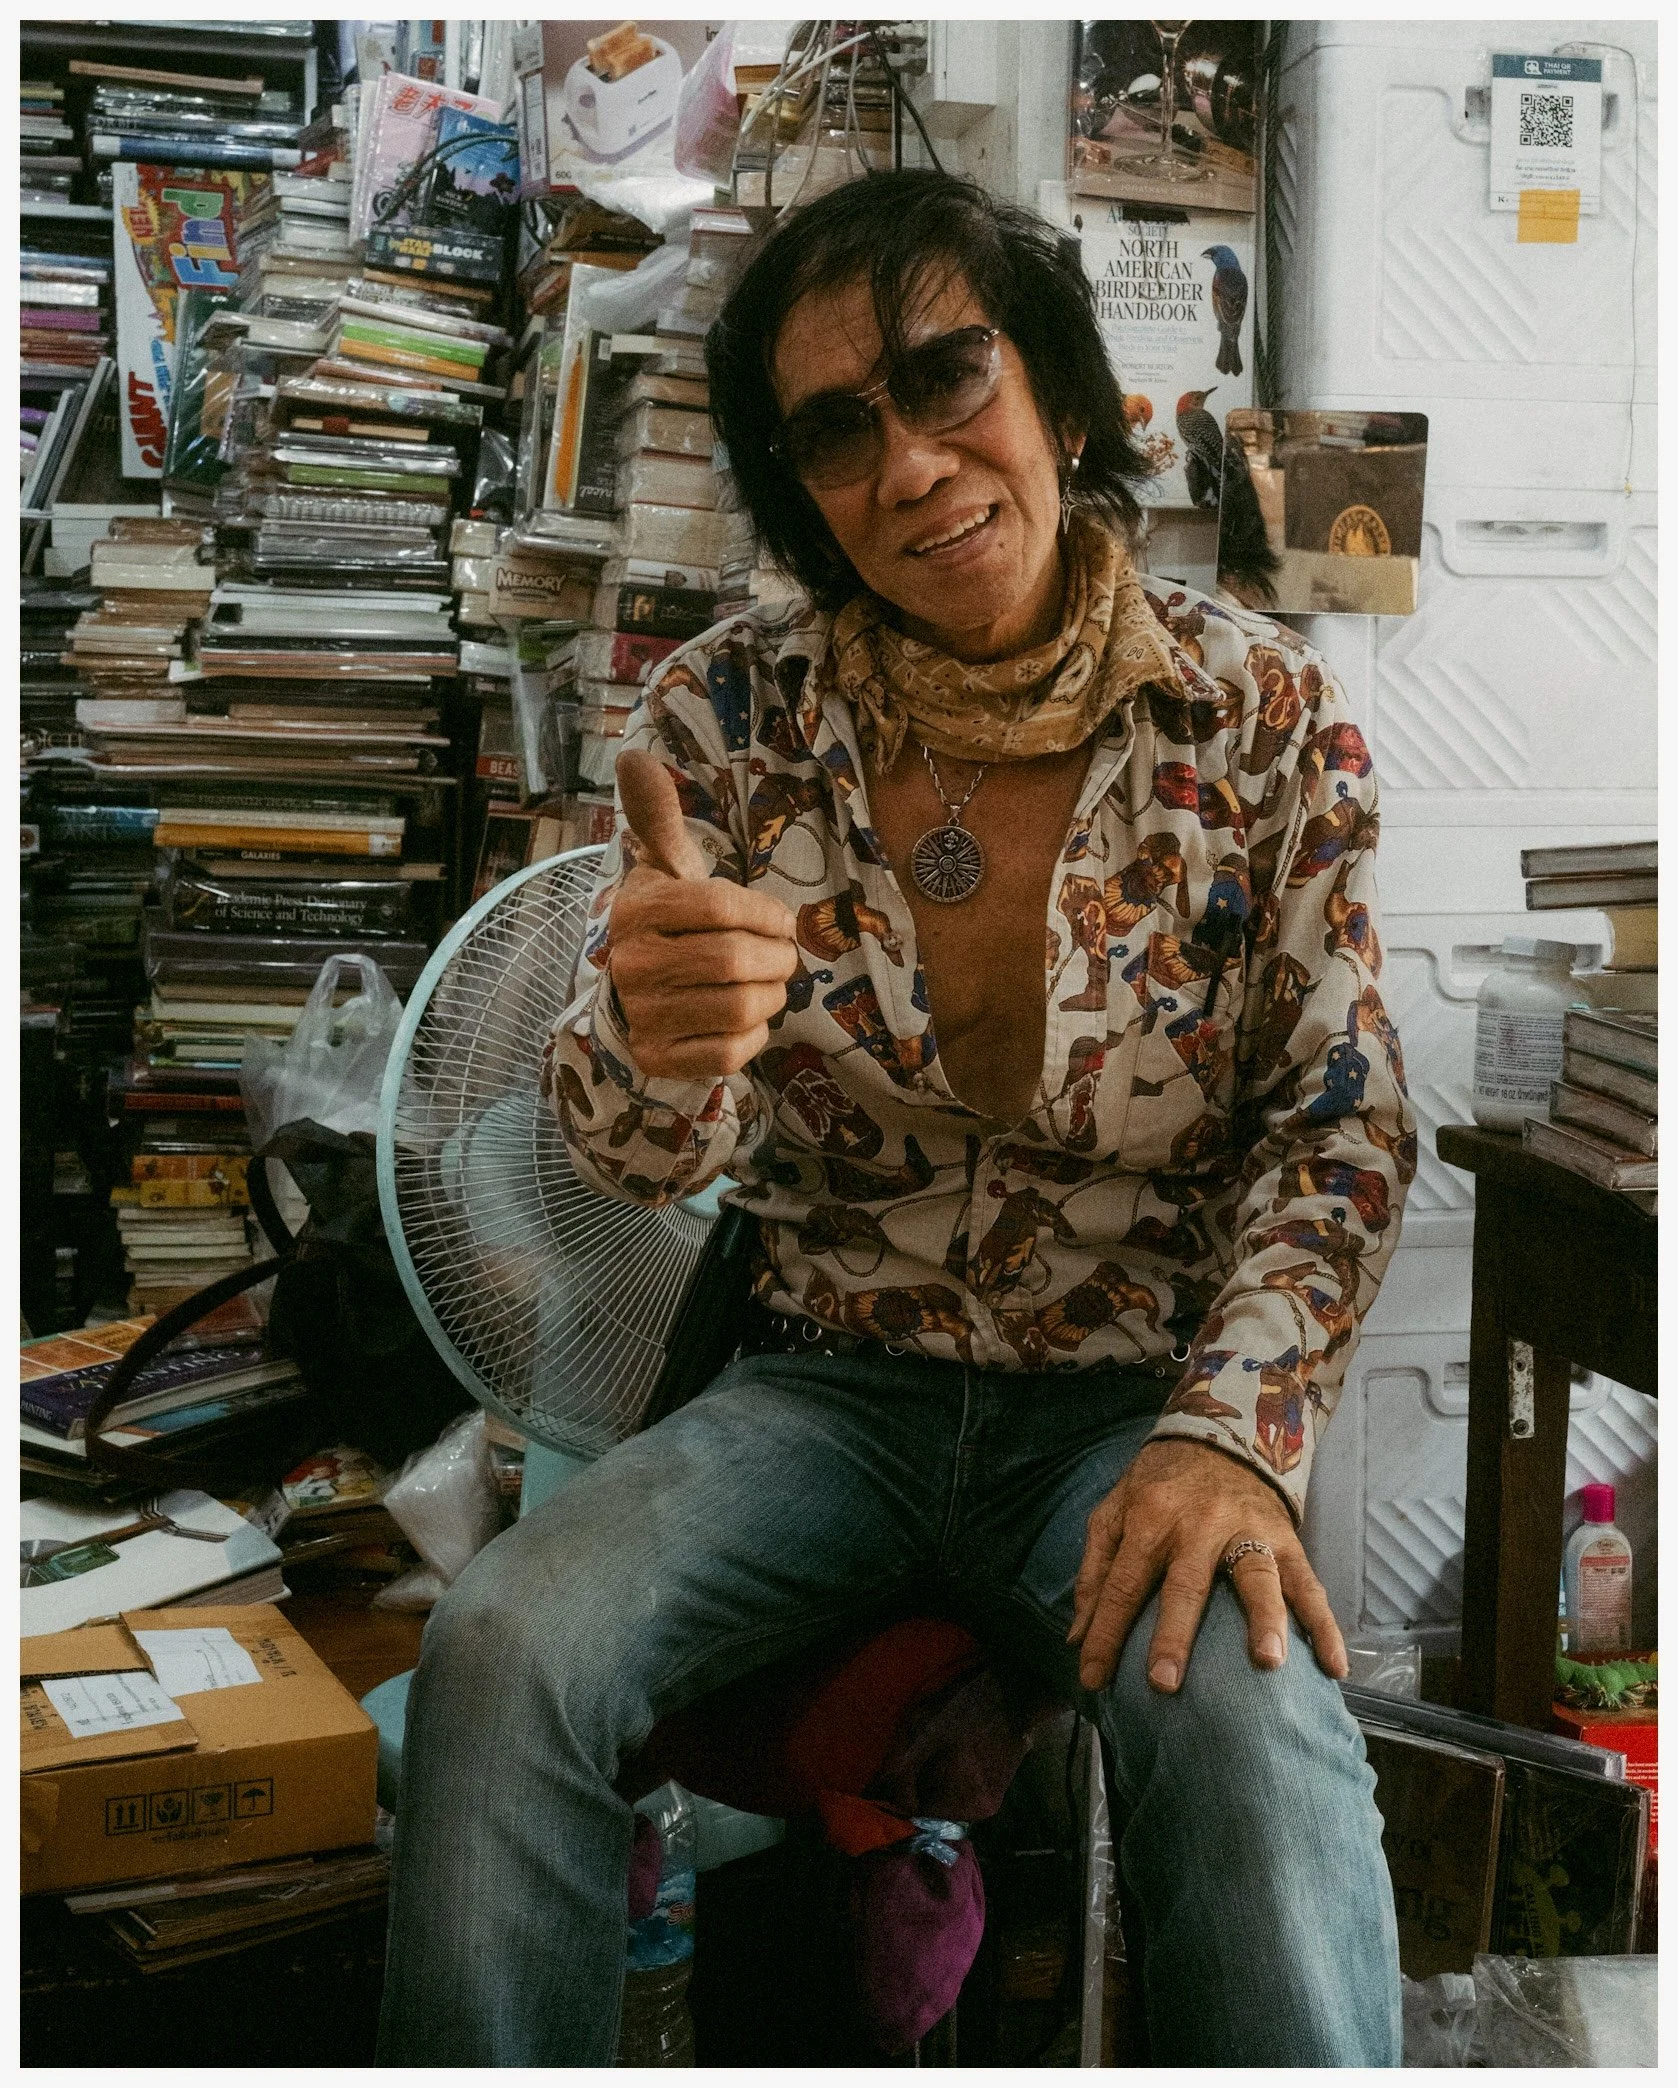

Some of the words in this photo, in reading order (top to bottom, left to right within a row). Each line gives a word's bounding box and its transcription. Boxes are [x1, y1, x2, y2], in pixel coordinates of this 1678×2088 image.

[1543, 61, 1561, 69] THAI
[161, 187, 239, 287] Find
[399, 238, 432, 249] STAR
[433, 243, 485, 260] BLOCK
[1119, 239, 1179, 259] NORTH
[1104, 260, 1194, 280] AMERICAN
[1094, 280, 1204, 301] BIRDFEEDER
[1099, 302, 1198, 322] HANDBOOK
[127, 371, 168, 469] GIANT
[496, 567, 567, 591] MEMORY
[489, 761, 520, 777] BEAS
[240, 851, 281, 861] GALAXIES
[275, 894, 303, 906] Press
[214, 905, 228, 918] of
[230, 906, 274, 920] Science
[276, 908, 297, 921] and
[299, 909, 364, 928] Technology
